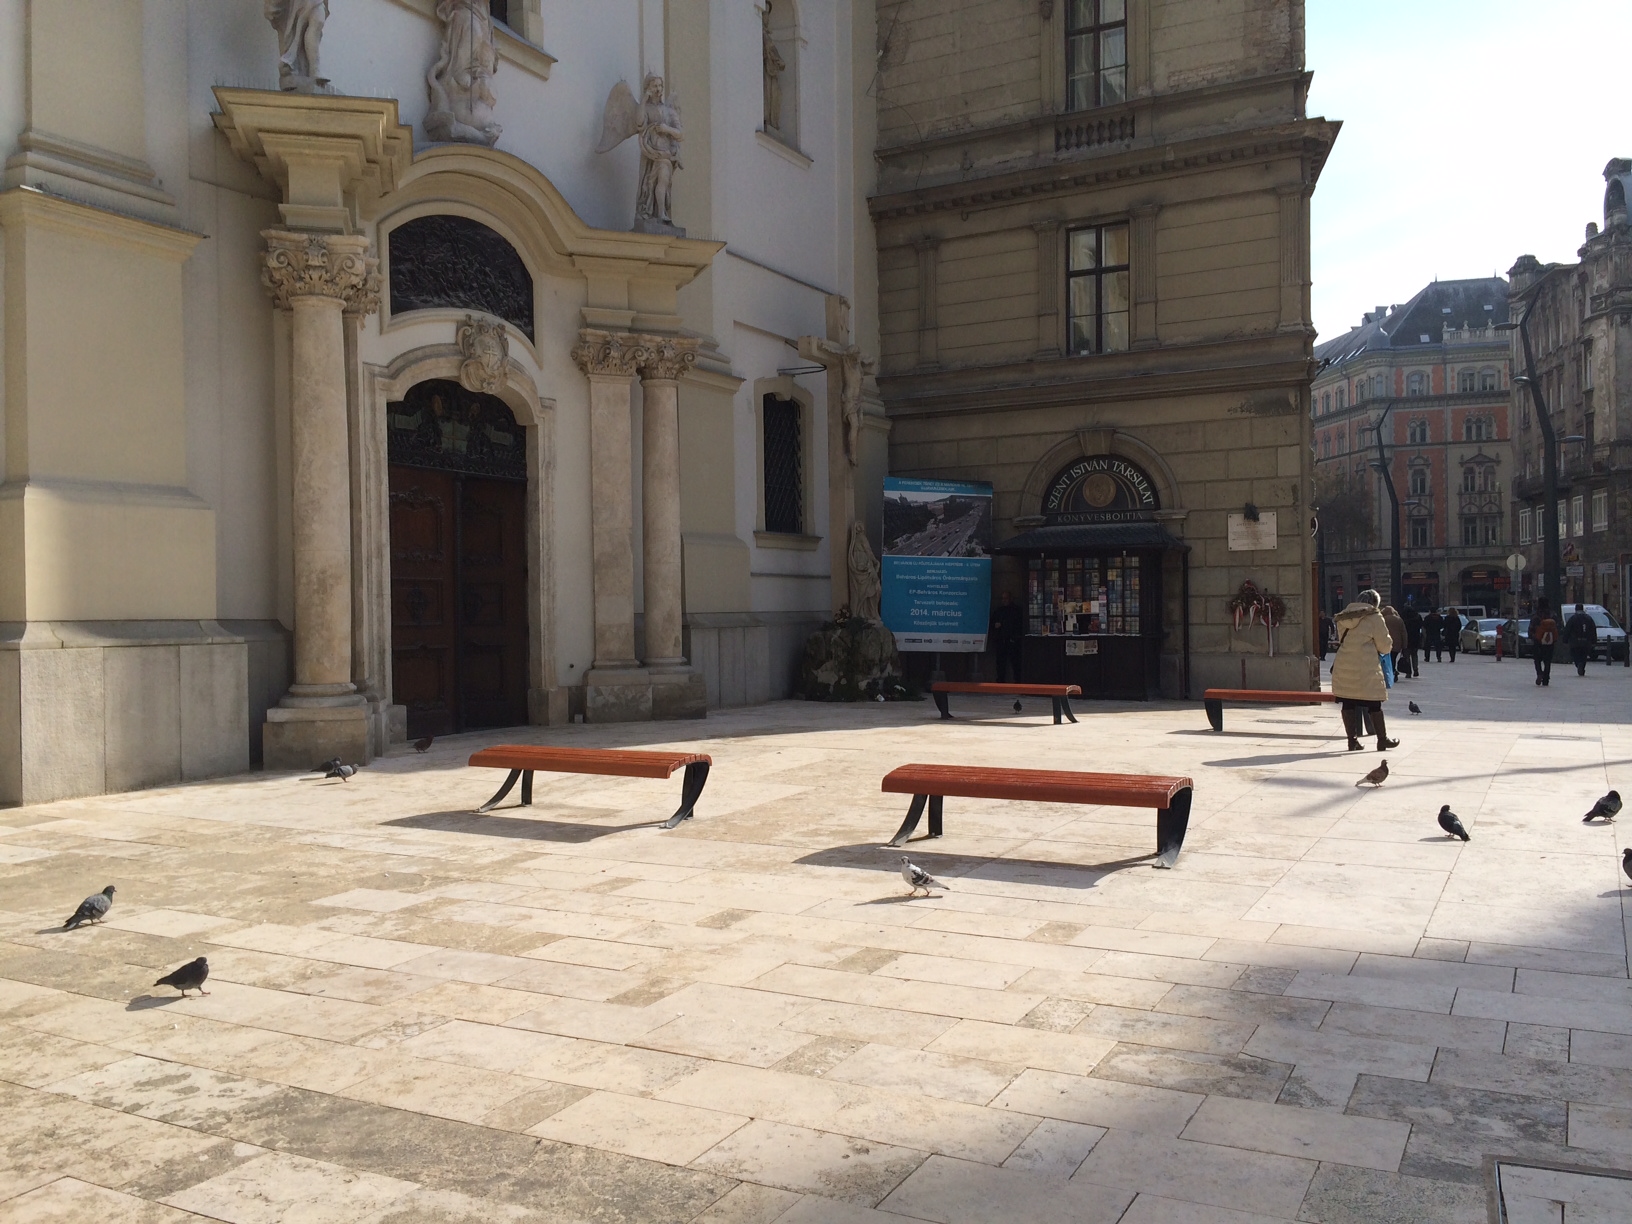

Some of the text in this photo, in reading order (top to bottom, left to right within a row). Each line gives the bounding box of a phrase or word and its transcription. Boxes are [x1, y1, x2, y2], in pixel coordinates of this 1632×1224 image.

[1048, 459, 1154, 509] SZENT ISTVÁN TÁRSULAT
[910, 608, 962, 617] 2014. március
